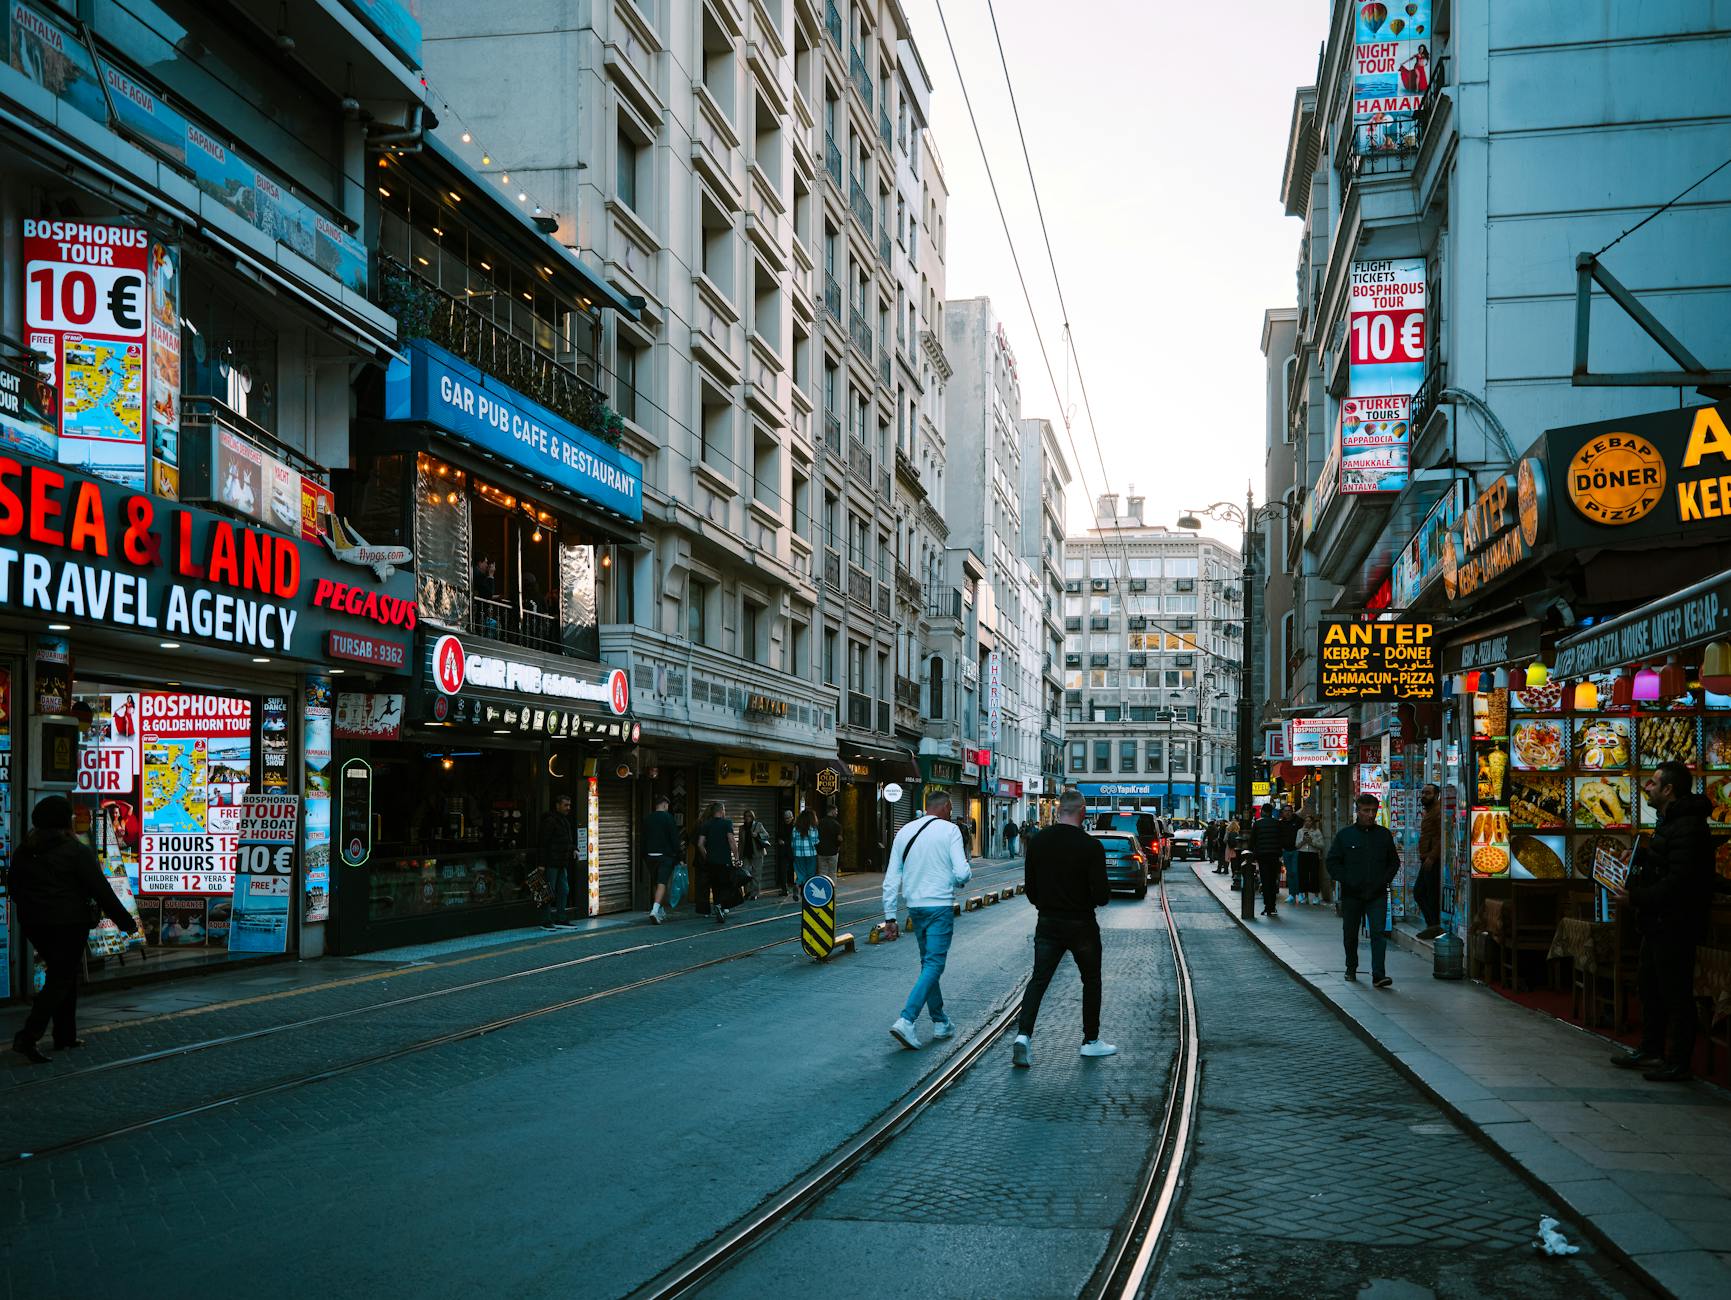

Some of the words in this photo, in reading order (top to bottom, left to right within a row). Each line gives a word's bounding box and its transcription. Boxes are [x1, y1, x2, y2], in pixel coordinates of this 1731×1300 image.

[16, 6, 63, 51] ANTALYA
[1356, 43, 1399, 59] NIGHT
[1359, 58, 1395, 74] TOUR
[108, 70, 128, 96] SILE
[127, 81, 154, 113] AGVA
[1356, 96, 1424, 114] HAMAM
[188, 126, 226, 163] SAPANCA
[256, 175, 280, 201] BURSA
[24, 219, 148, 248] BOSPHORUS
[315, 217, 343, 244] ISLANDS
[58, 242, 114, 265] TOUR
[1354, 261, 1393, 273] FLIGHT
[1353, 272, 1395, 284] TICKETS
[1353, 282, 1424, 297] BOSPHROUS
[31, 268, 97, 325] 10
[107, 275, 142, 330] €
[1373, 296, 1404, 309] TOUR
[31, 335, 54, 345] FREE
[151, 322, 180, 352] HAMAM
[1353, 314, 1394, 361] 10
[1400, 313, 1424, 358] €
[1358, 397, 1408, 411] TURKEY
[1366, 408, 1400, 420] TOURS
[441, 376, 474, 416] GAR
[478, 396, 509, 433] PUB
[513, 415, 548, 454] CAFE
[550, 436, 559, 459] &
[562, 442, 635, 498] RESTAURANT
[1343, 435, 1393, 444] CAPPADOCIA
[1580, 437, 1652, 465] KEBAP
[1343, 459, 1391, 468] PAMUKKALE
[274, 465, 289, 486] YACHT
[1576, 467, 1658, 491] DÖNER
[1342, 483, 1378, 492] ANTALYA
[1463, 475, 1508, 556] ANTEP
[0, 457, 109, 558] SEA
[123, 495, 163, 567] &
[177, 509, 301, 600] LAND
[359, 547, 405, 564] flypgs.com
[0, 547, 157, 629] TRAVEL
[166, 584, 298, 652] AGENCY
[314, 577, 419, 631] PEGASUS
[1324, 623, 1433, 644] ANTEP
[1554, 652, 1576, 678] ANTEP
[1576, 642, 1599, 672] KEBAP
[1621, 620, 1649, 659] HOUSE
[1651, 608, 1681, 650] ANTEP
[1684, 592, 1720, 639] KEBAP
[333, 633, 373, 659] TURSAB
[380, 640, 403, 665] 9362
[1323, 647, 1369, 660] KEBAP
[41, 696, 62, 706] DANCE
[268, 697, 284, 705] SUFI
[991, 654, 999, 737] PHARMACY
[142, 695, 251, 718] BOSPHORUS
[264, 703, 286, 711] DANCE
[143, 719, 151, 732] &
[152, 719, 193, 732] GOLDEN
[195, 718, 224, 731] HORN
[1329, 726, 1348, 734] TOURS
[78, 750, 125, 770] IGHT
[79, 771, 120, 790] OUR
[243, 796, 298, 804] BOSPHORUS
[220, 809, 241, 819] FRE
[242, 804, 296, 819] TOUR
[241, 819, 257, 829] BY
[261, 819, 295, 829] BOAT
[240, 830, 247, 839] 2
[250, 830, 294, 839] HOURS
[145, 837, 154, 852] 3
[159, 837, 214, 852] HOURS
[220, 837, 239, 852] 15
[145, 856, 154, 871] 2
[159, 856, 214, 871] HOURS
[220, 856, 237, 871] 10
[237, 846, 270, 873] 10
[273, 846, 293, 874] €
[182, 875, 201, 890] 12
